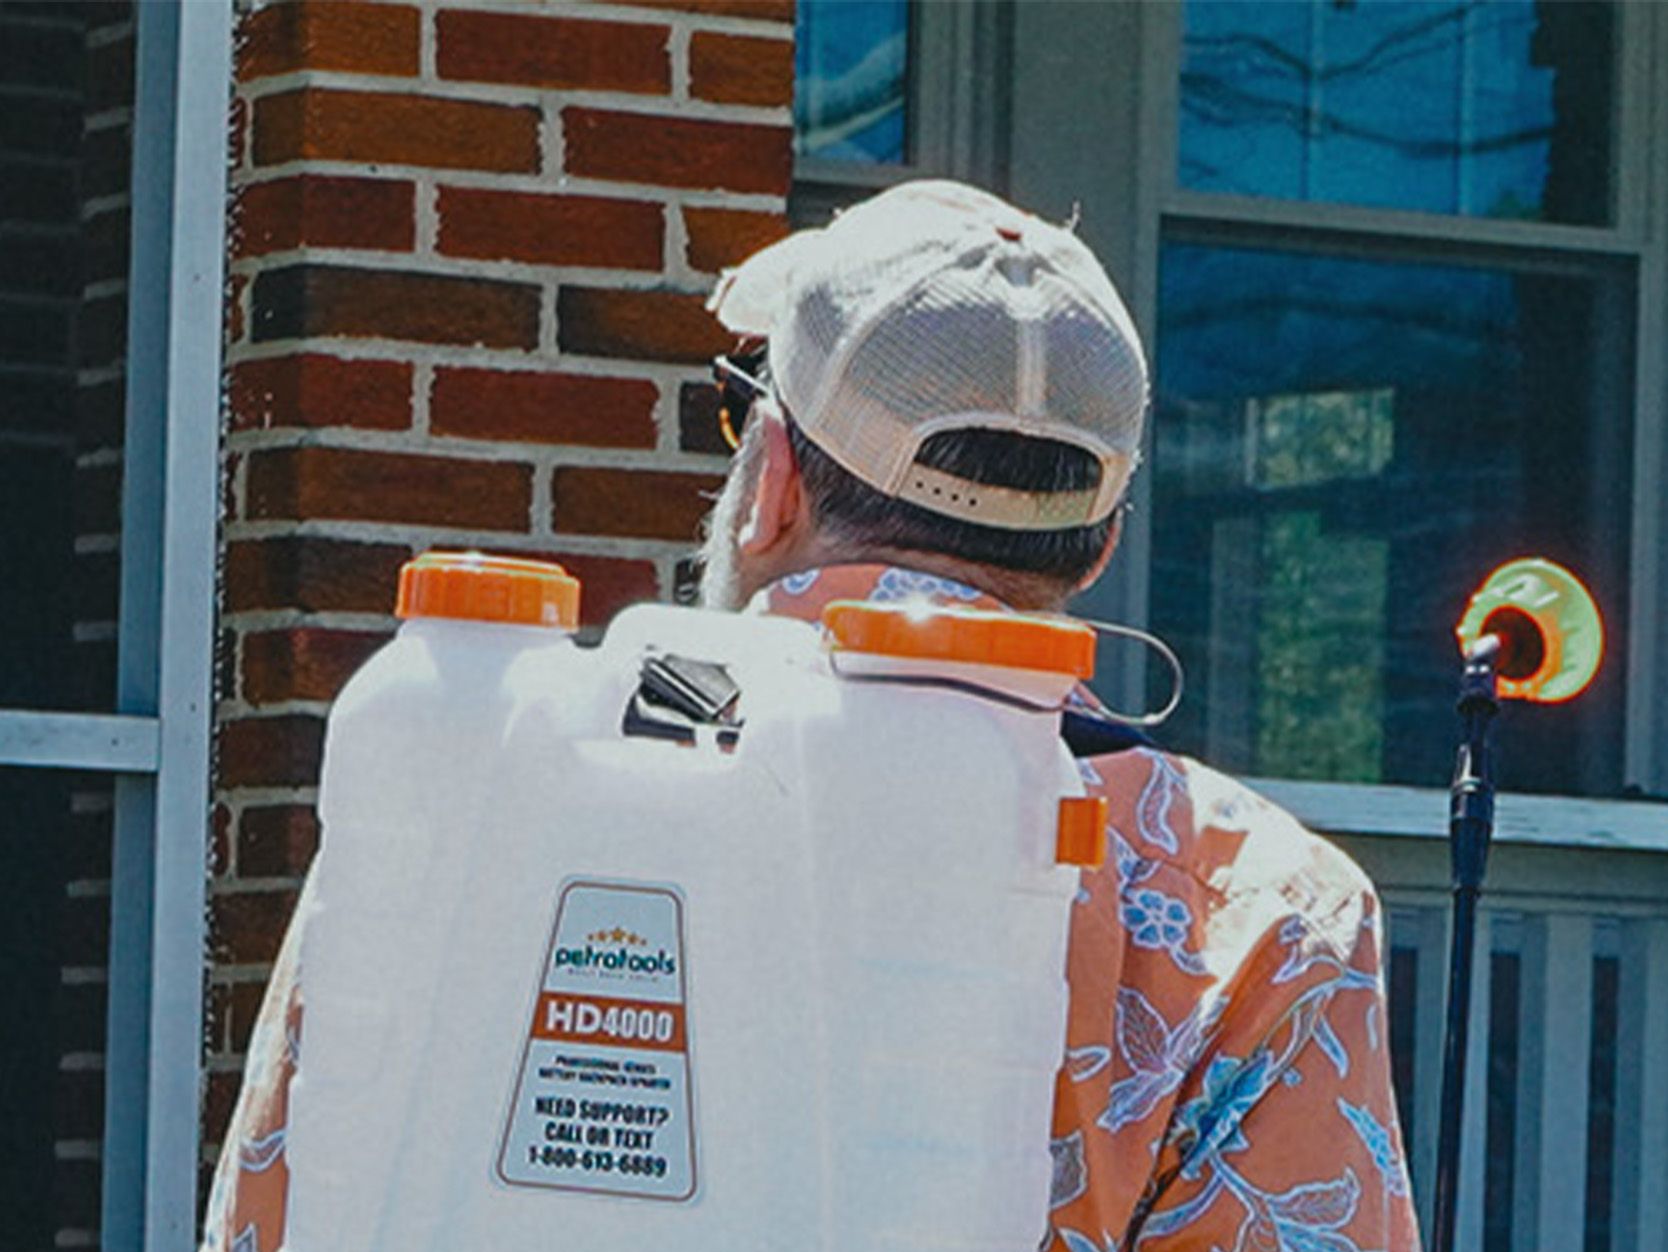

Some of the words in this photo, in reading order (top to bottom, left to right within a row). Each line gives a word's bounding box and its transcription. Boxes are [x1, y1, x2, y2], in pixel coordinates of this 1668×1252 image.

[555, 945, 676, 974] petrotools
[546, 1001, 673, 1042] HD4000
[535, 1097, 576, 1119] NEED
[579, 1099, 670, 1127] SUPPORT?
[544, 1122, 583, 1144] CALL
[586, 1126, 610, 1146] OR
[613, 1129, 654, 1150] TEXT
